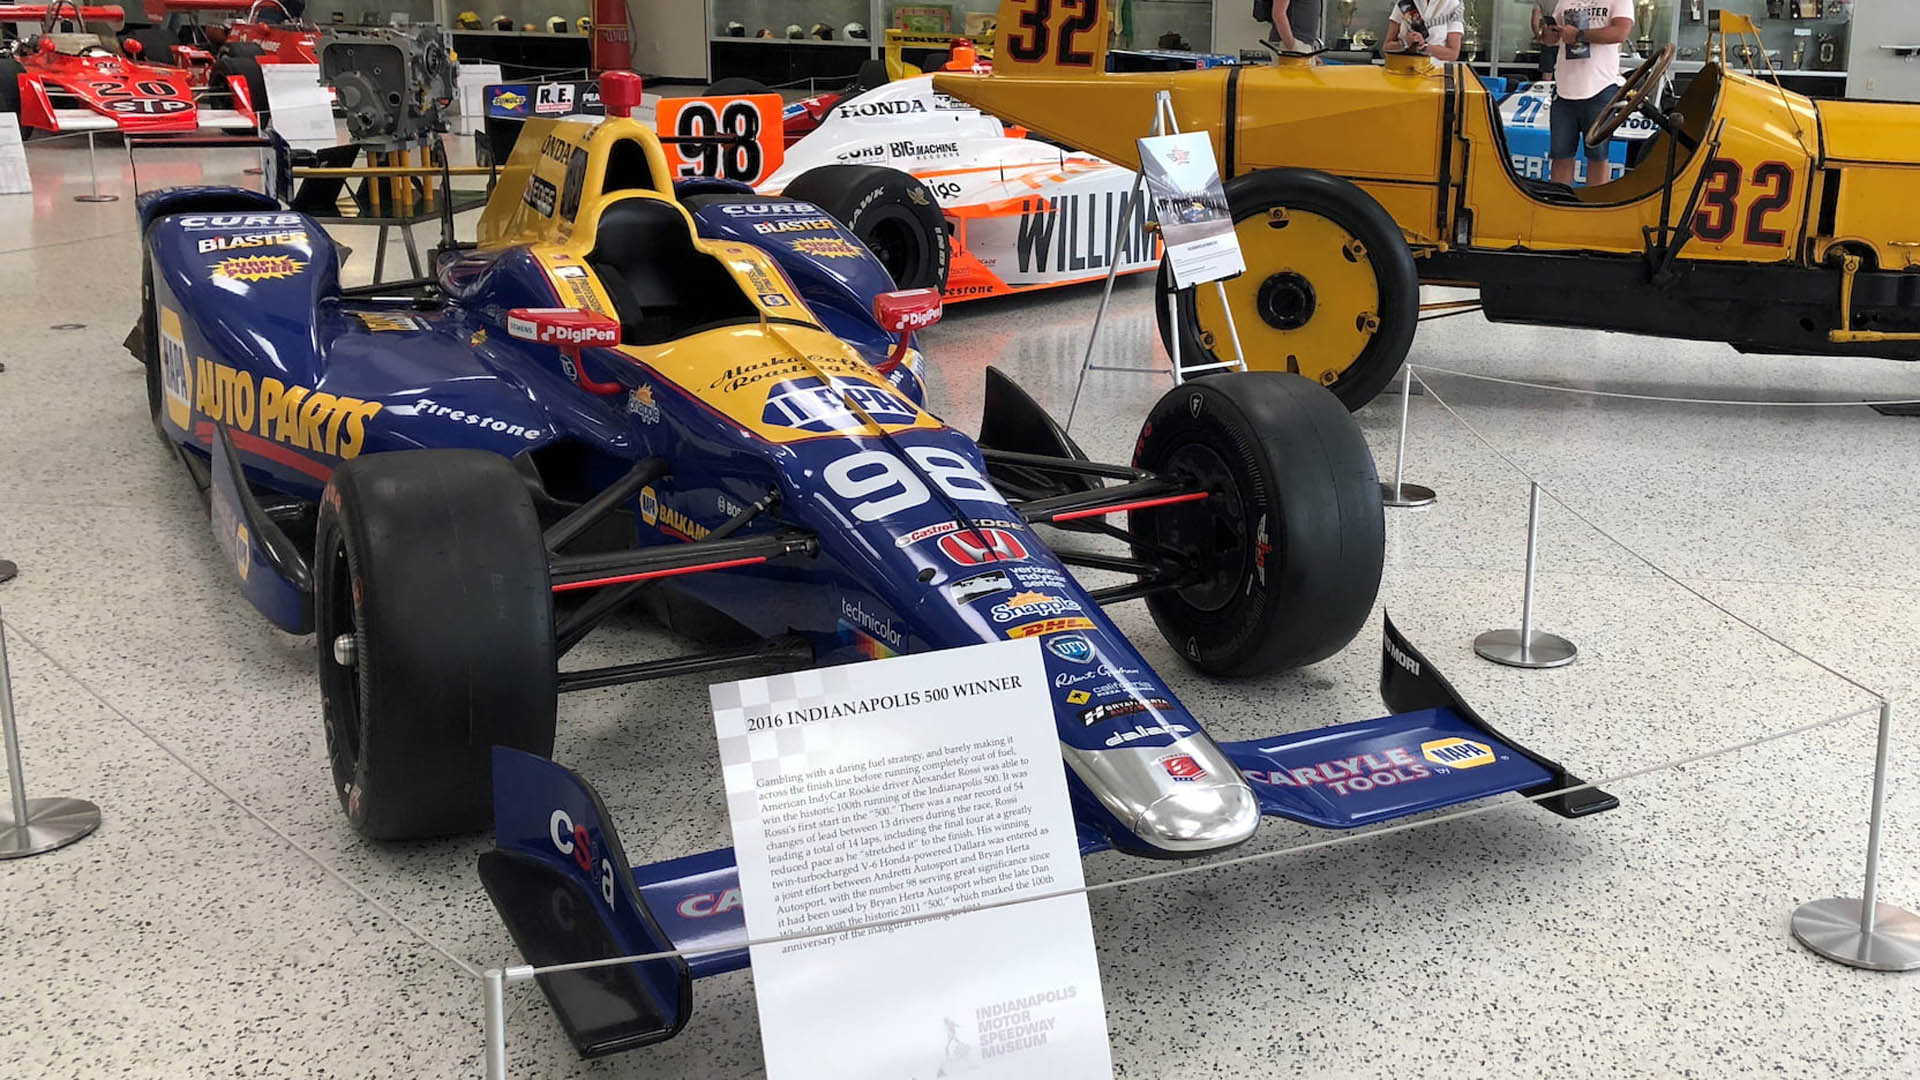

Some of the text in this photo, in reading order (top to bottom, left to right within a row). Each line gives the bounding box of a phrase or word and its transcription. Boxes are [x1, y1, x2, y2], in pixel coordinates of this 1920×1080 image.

[1007, 0, 1100, 67] 32
[89, 81, 178, 97] 20
[113, 98, 186, 112] STP
[840, 99, 928, 119] HONDA
[1512, 95, 1543, 123] 27
[675, 100, 761, 184] 98
[889, 141, 958, 158] BIG MACHINE
[722, 203, 817, 214] CURB
[848, 185, 886, 231] AWK
[1692, 157, 1795, 248] 32
[179, 214, 301, 228] CURB
[943, 284, 994, 297] restone
[556, 327, 616, 343] DigiPen
[196, 356, 384, 460] AUTO PARTS
[414, 398, 541, 440] Firestone
[823, 446, 1008, 521] 98
[911, 521, 956, 542] Castrol
[841, 596, 902, 647] technicolor
[991, 595, 1082, 623] Snapple
[1022, 619, 1085, 636] DHL
[1056, 641, 1088, 655] UFD
[747, 674, 1023, 732] 2016 INDIANAPOLIS 500 WINNER
[1241, 747, 1417, 787] CARLYLE
[1430, 742, 1487, 763] NAPA
[758, 789, 788, 800] across
[789, 784, 805, 795] the
[806, 779, 833, 791] finish
[834, 777, 852, 787] line
[853, 771, 883, 783] before
[884, 764, 921, 778] running
[921, 755, 969, 771] completely
[970, 752, 986, 762] out
[761, 798, 806, 813] American
[808, 790, 846, 804] IndyCar
[848, 784, 880, 797] Rookie
[881, 779, 910, 791] driver
[911, 770, 956, 785] Alexander
[957, 764, 981, 777] Rossi
[982, 763, 1000, 772] was
[1000, 758, 1019, 769] able
[1326, 763, 1432, 796] TOOLS
[762, 815, 781, 825] win
[782, 812, 798, 821] the
[799, 805, 835, 818] historic
[836, 799, 862, 811] 100th
[863, 792, 900, 807] running
[912, 787, 927, 798] the
[927, 777, 983, 795] Indianapolis
[1010, 770, 1028, 779] was
[767, 850, 804, 864] leading
[812, 841, 835, 854] total
[883, 824, 927, 841] including
[927, 821, 943, 832] the
[943, 816, 964, 829] final
[965, 814, 984, 825] four
[1002, 804, 1031, 820] greatly
[953, 838, 986, 852] Dallara
[987, 836, 1005, 845] was
[1005, 827, 1038, 841] entered
[781, 887, 804, 903] joint
[804, 882, 831, 895] effort
[831, 875, 872, 889] between
[871, 865, 911, 881] Andretti
[911, 856, 959, 874] Autosport
[957, 851, 977, 863] and
[977, 847, 1004, 861] Bryan
[1005, 843, 1030, 854] Herta
[828, 891, 851, 903] with
[851, 887, 867, 899] the
[868, 881, 904, 895] number
[918, 870, 952, 885] serving
[952, 864, 976, 880] great
[976, 856, 1028, 874] significance
[1028, 852, 1050, 862] since
[786, 913, 805, 926] had
[806, 907, 830, 921] been
[831, 902, 854, 916] used
[869, 894, 897, 909] Bryan
[898, 888, 925, 902] Herta
[926, 878, 971, 897] Autosport
[972, 875, 997, 886] when
[997, 871, 1013, 881] the
[1013, 867, 1030, 878] late
[1030, 863, 1050, 874] Dan
[975, 985, 1078, 1020] INDIANAPOLIS
[978, 1010, 1032, 1034] MOTOR
[979, 1016, 1057, 1047] SPEEDWAY
[981, 1031, 1048, 1060] MUSEUM
